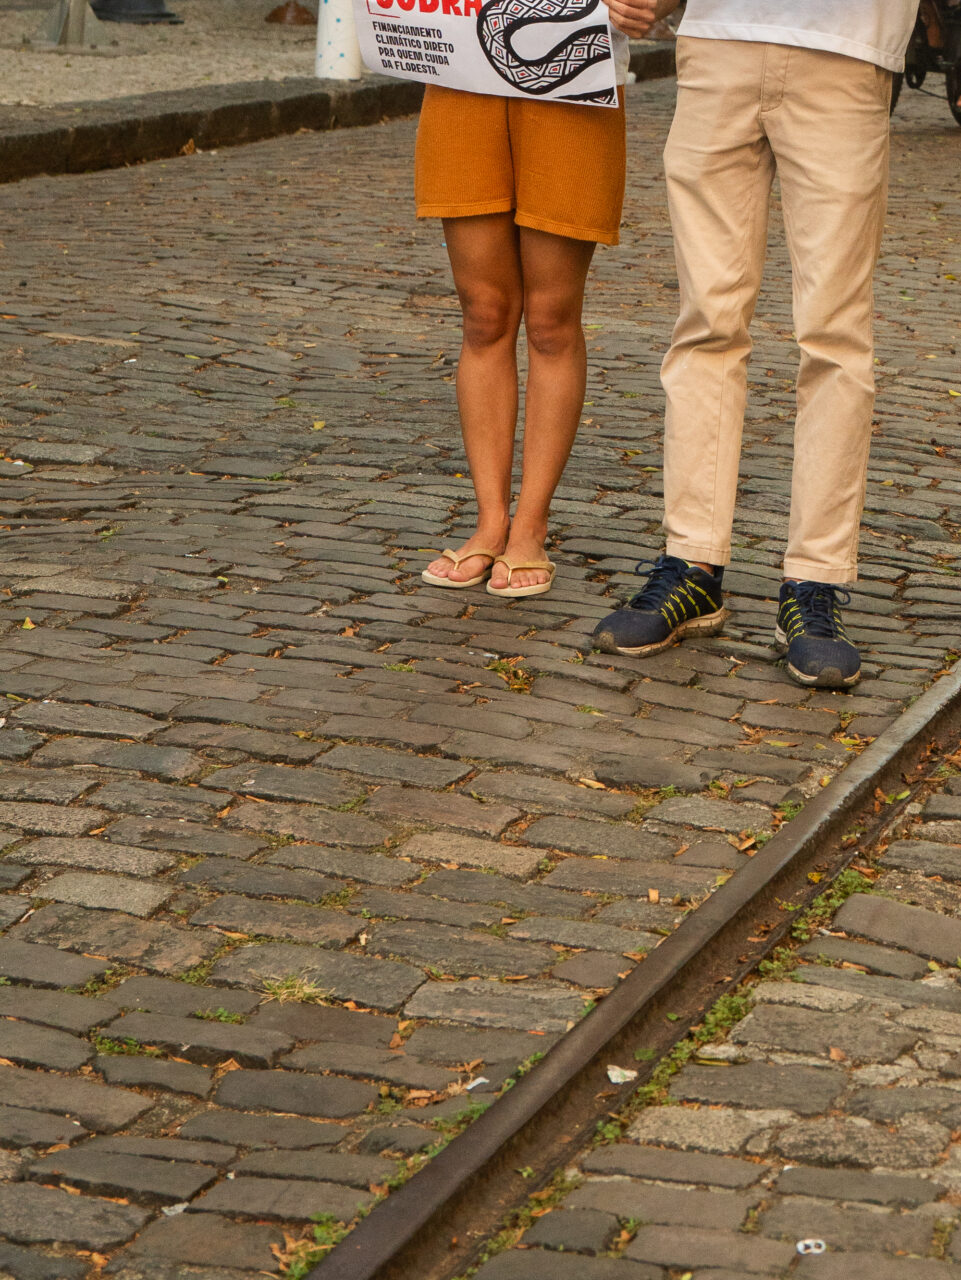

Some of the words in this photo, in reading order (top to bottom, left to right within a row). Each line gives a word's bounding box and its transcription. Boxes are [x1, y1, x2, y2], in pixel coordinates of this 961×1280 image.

[373, 22, 443, 39] FINANCIAMENTO
[376, 34, 422, 51] CLIMÁTICO
[424, 40, 454, 53] DIRETO
[378, 47, 396, 58] PRA
[397, 49, 423, 62] QUEM
[425, 53, 449, 65] CUIDA
[382, 59, 393, 69] DA
[395, 60, 440, 76] FLORESTA.
